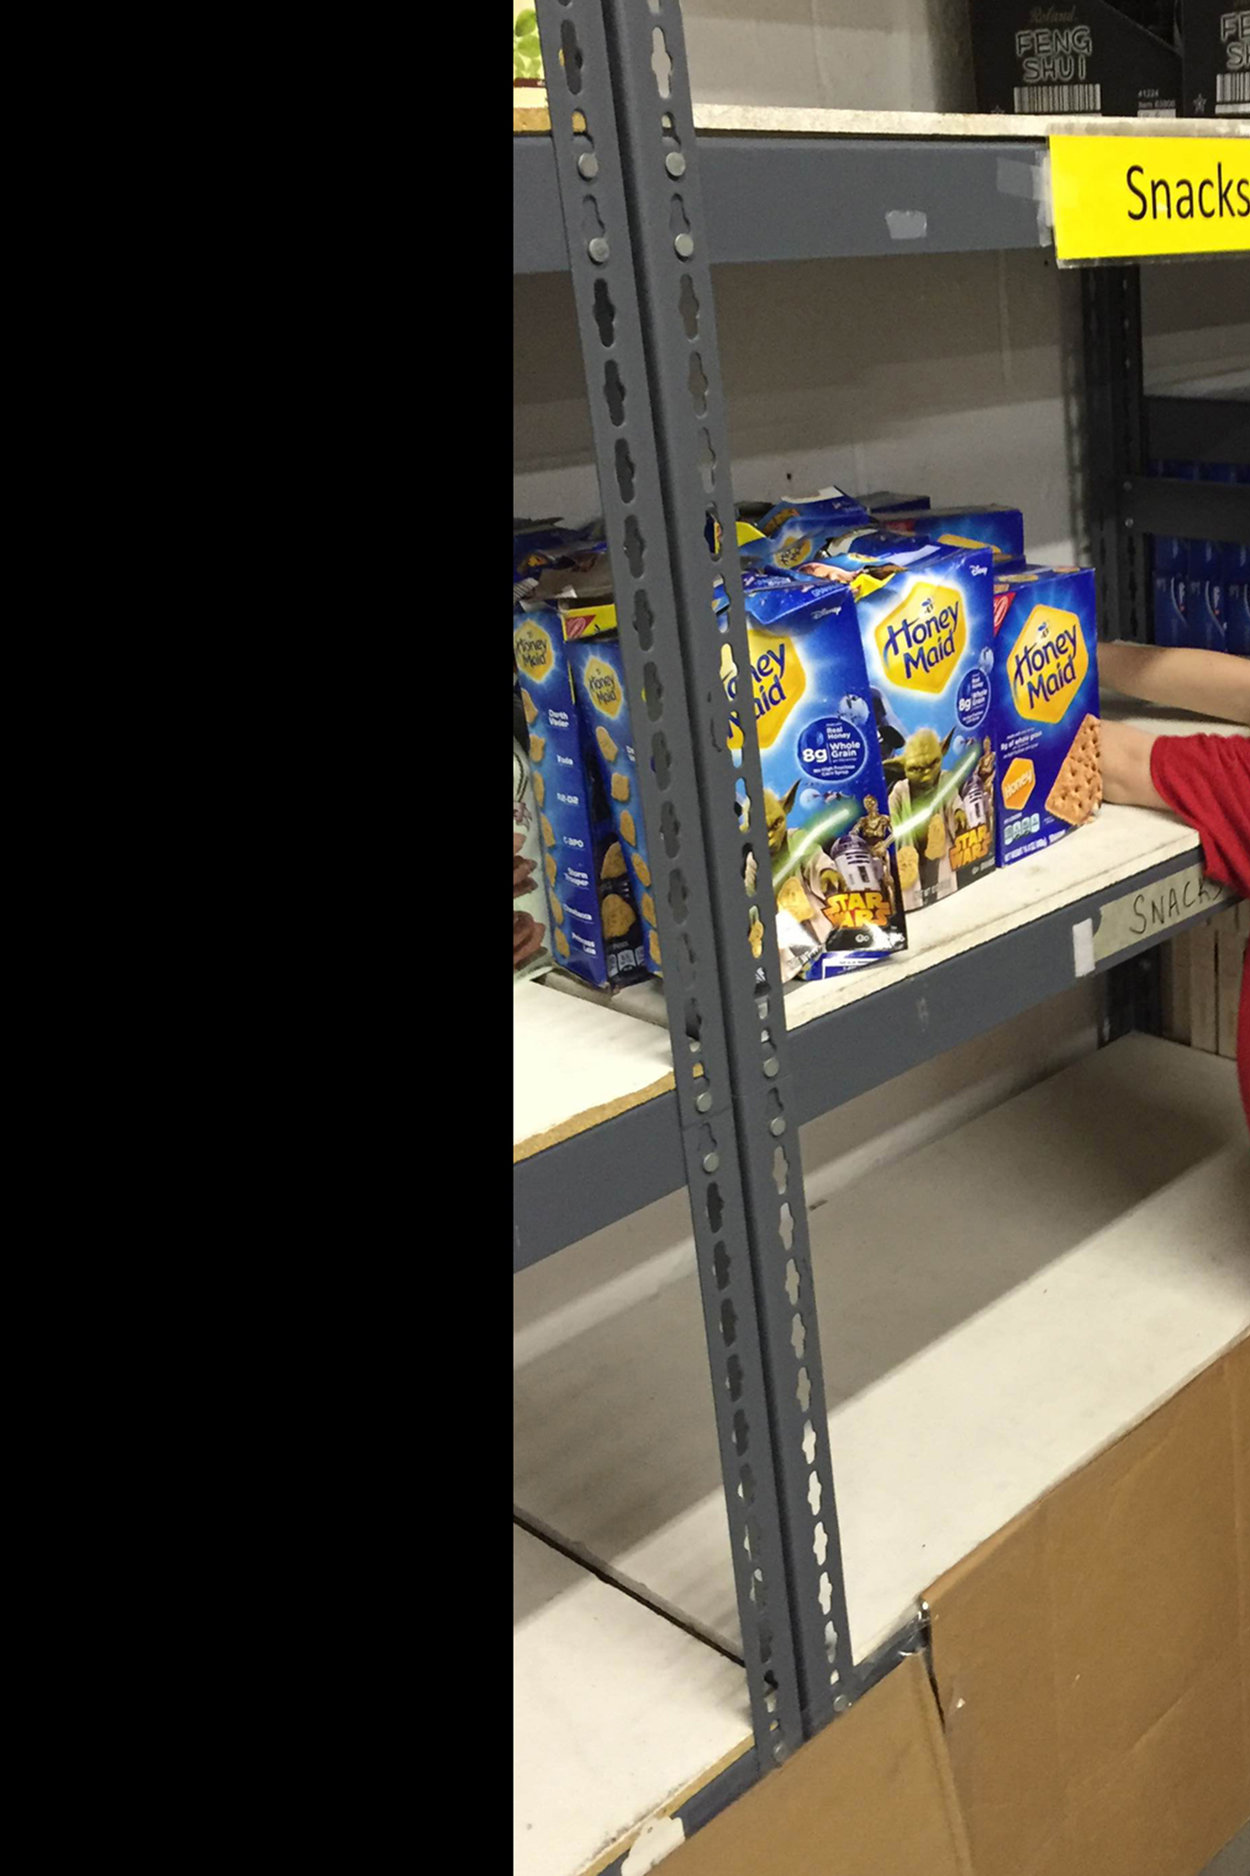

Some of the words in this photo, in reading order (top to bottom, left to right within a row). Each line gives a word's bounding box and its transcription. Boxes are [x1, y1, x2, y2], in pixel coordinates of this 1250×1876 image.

[1015, 25, 1092, 57] FENG
[1022, 54, 1087, 84] SHUI
[884, 601, 959, 662] Honey
[903, 629, 956, 679] Maid
[1014, 624, 1077, 690] Honey
[1027, 654, 1077, 709] Maid
[958, 698, 971, 712] 8g
[802, 748, 828, 763] 8g
[830, 741, 861, 751] Whole
[830, 749, 857, 759] Grain
[955, 823, 991, 850] STAR
[949, 836, 991, 872] WARS
[825, 891, 884, 913] STAR
